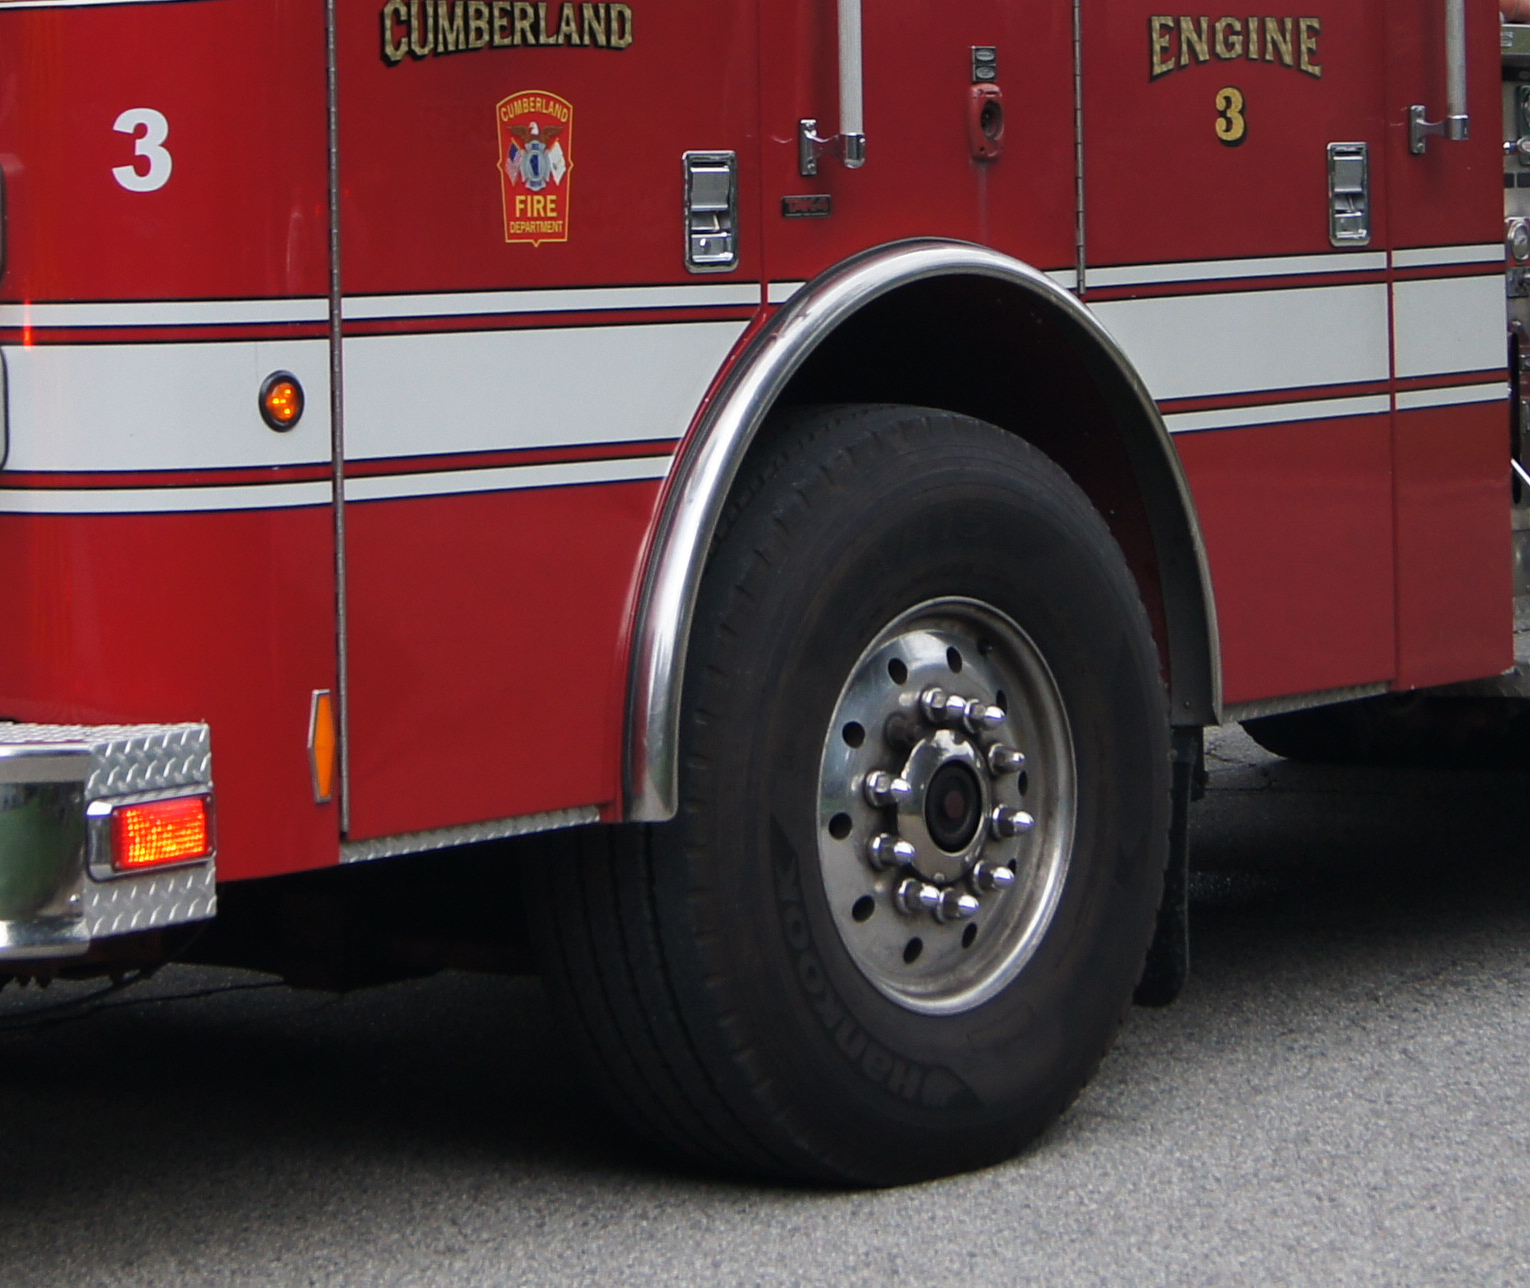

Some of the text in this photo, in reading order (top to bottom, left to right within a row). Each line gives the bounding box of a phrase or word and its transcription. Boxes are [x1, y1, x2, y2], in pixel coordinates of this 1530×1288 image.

[1149, 15, 1322, 79] ENGINE
[500, 97, 569, 123] CUMBERLAND
[1215, 86, 1246, 142] 3
[112, 107, 173, 192] 3
[509, 220, 564, 234] DEPARTMENT
[515, 195, 558, 218] FIRE
